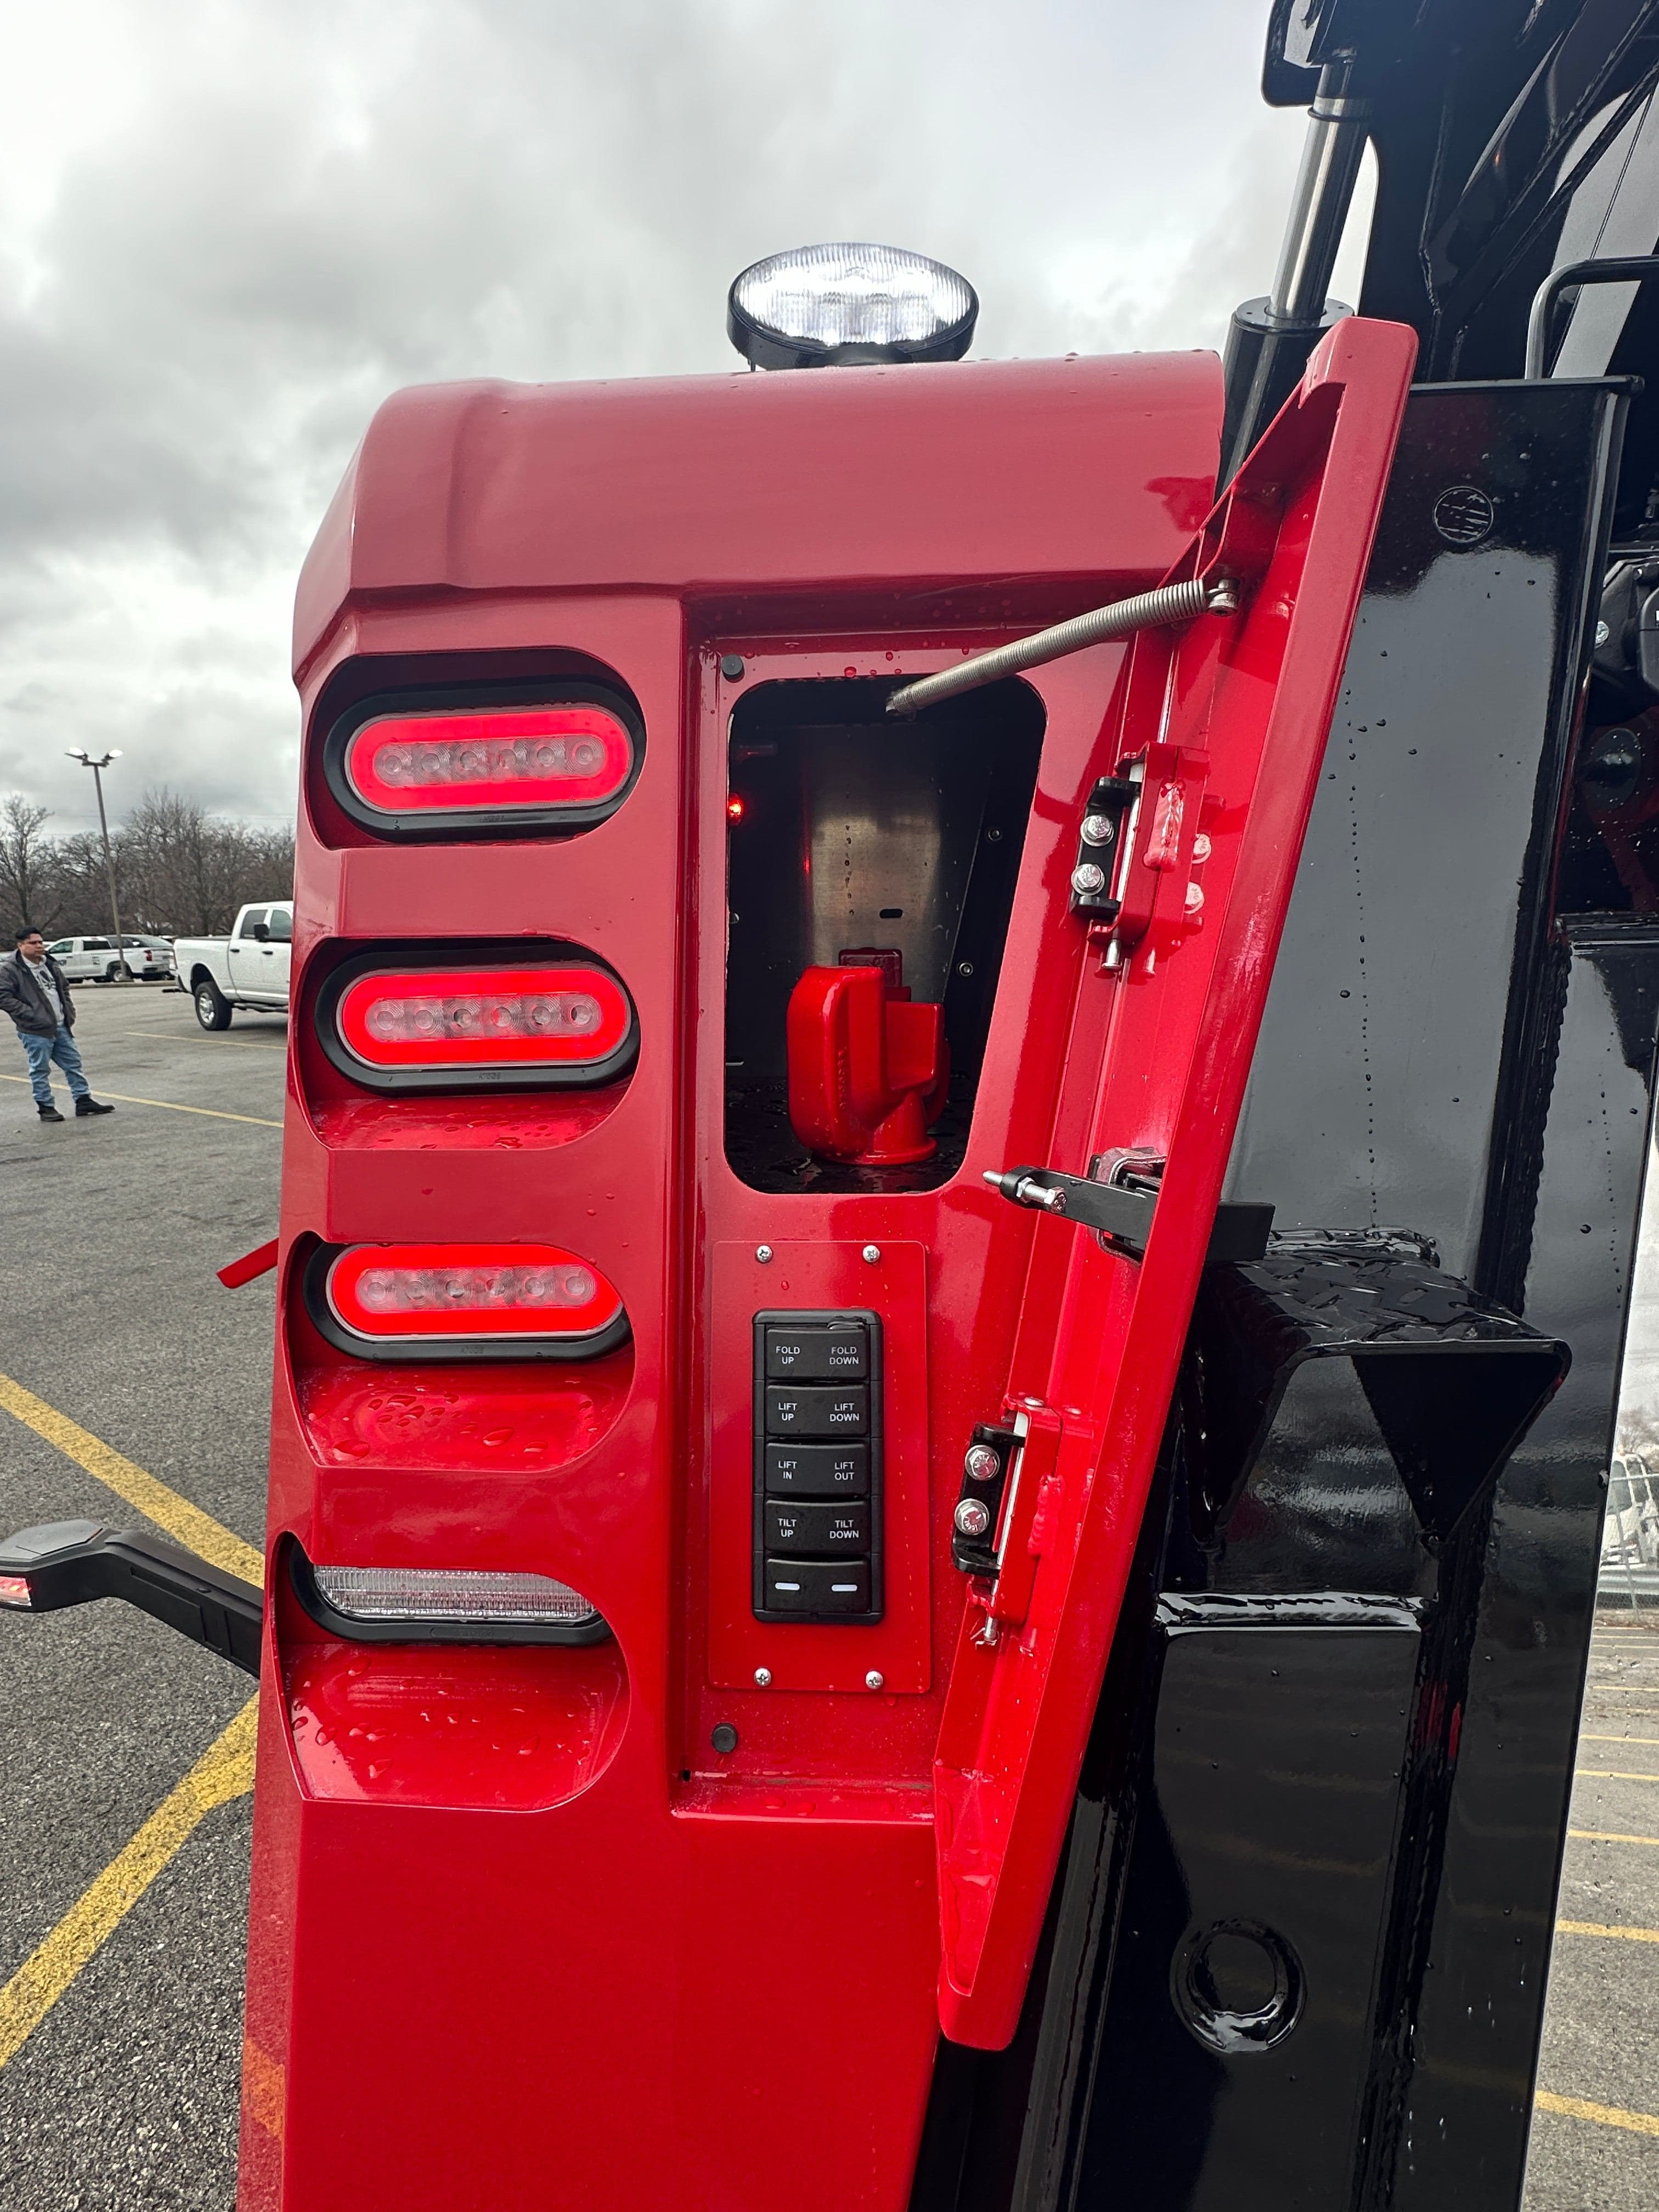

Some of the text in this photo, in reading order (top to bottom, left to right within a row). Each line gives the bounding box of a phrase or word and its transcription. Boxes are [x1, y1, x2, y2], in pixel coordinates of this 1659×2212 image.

[776, 1346, 800, 1355] FOLD
[831, 1346, 857, 1355] FOLD
[781, 1356, 794, 1365] UP
[829, 1357, 859, 1365] DOWN
[778, 1402, 798, 1411] LIFT
[834, 1403, 855, 1412] LIFT
[781, 1413, 794, 1421] UP
[830, 1413, 860, 1422] DOWN
[778, 1460, 797, 1469] LIFT
[834, 1461, 854, 1470] LIFT
[783, 1471, 792, 1480] IN
[834, 1472, 855, 1481] OUT
[777, 1518, 797, 1527] TILT
[834, 1520, 854, 1528] TILT
[781, 1528, 794, 1538] UP
[830, 1530, 860, 1539] DOWN
